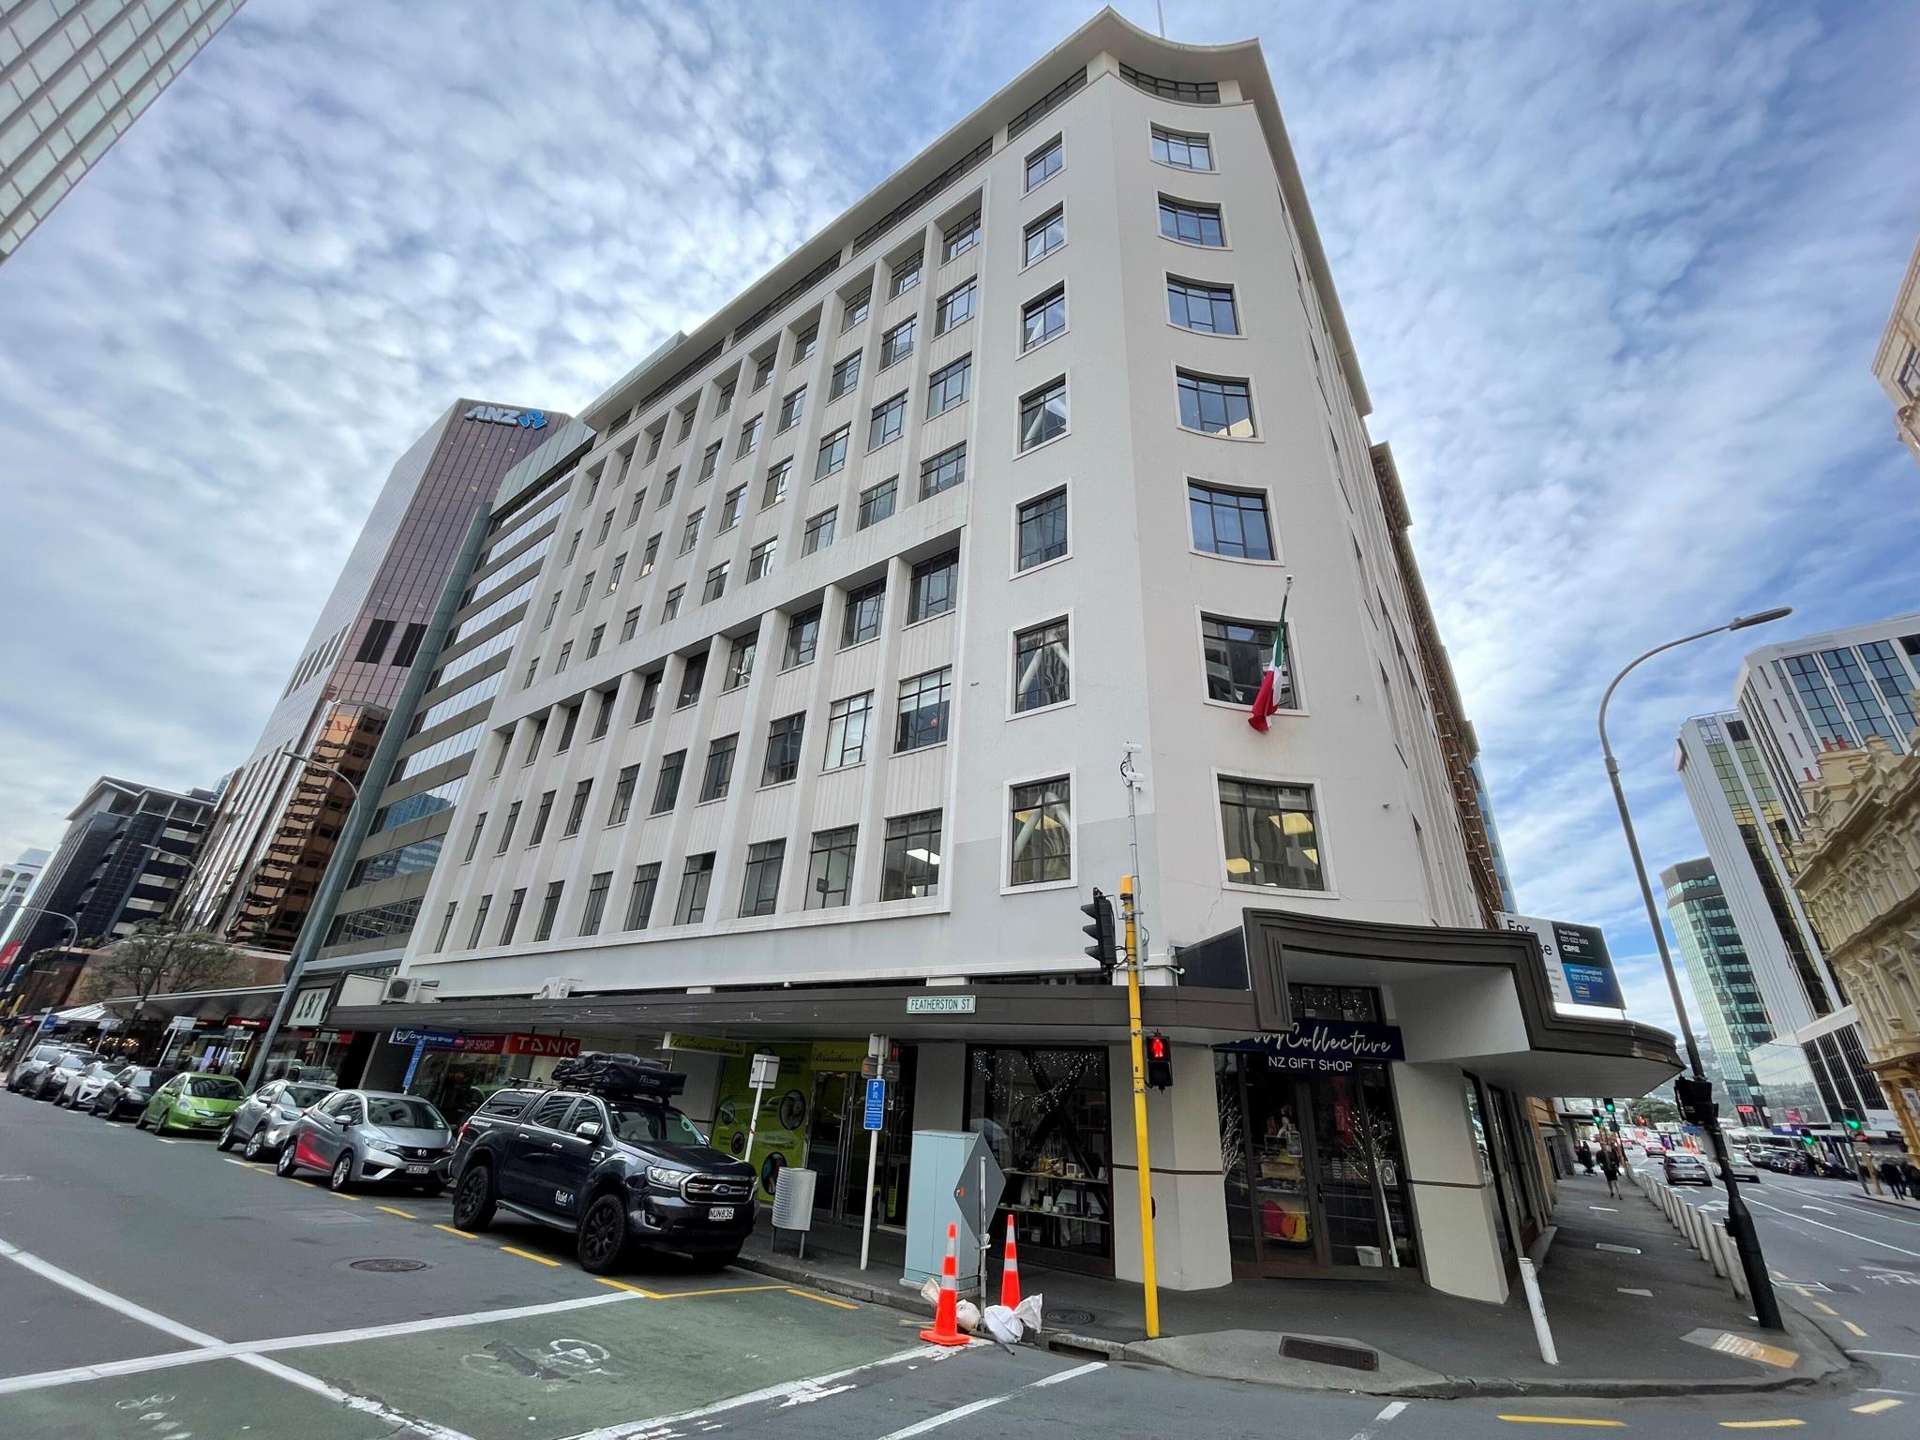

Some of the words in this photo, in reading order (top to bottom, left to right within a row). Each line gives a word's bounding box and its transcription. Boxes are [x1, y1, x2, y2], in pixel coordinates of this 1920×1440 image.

[464, 405, 520, 425] ANZ
[1507, 920, 1530, 933] For
[296, 992, 325, 1018] 187
[910, 999, 958, 1010] FEATHERSTON
[961, 999, 971, 1010] ST
[1286, 1022, 1392, 1055] Collective
[1268, 1056, 1287, 1069] NZ
[1288, 1058, 1317, 1070] GIFT
[1318, 1059, 1354, 1072] SHOP
[872, 1081, 880, 1091] P
